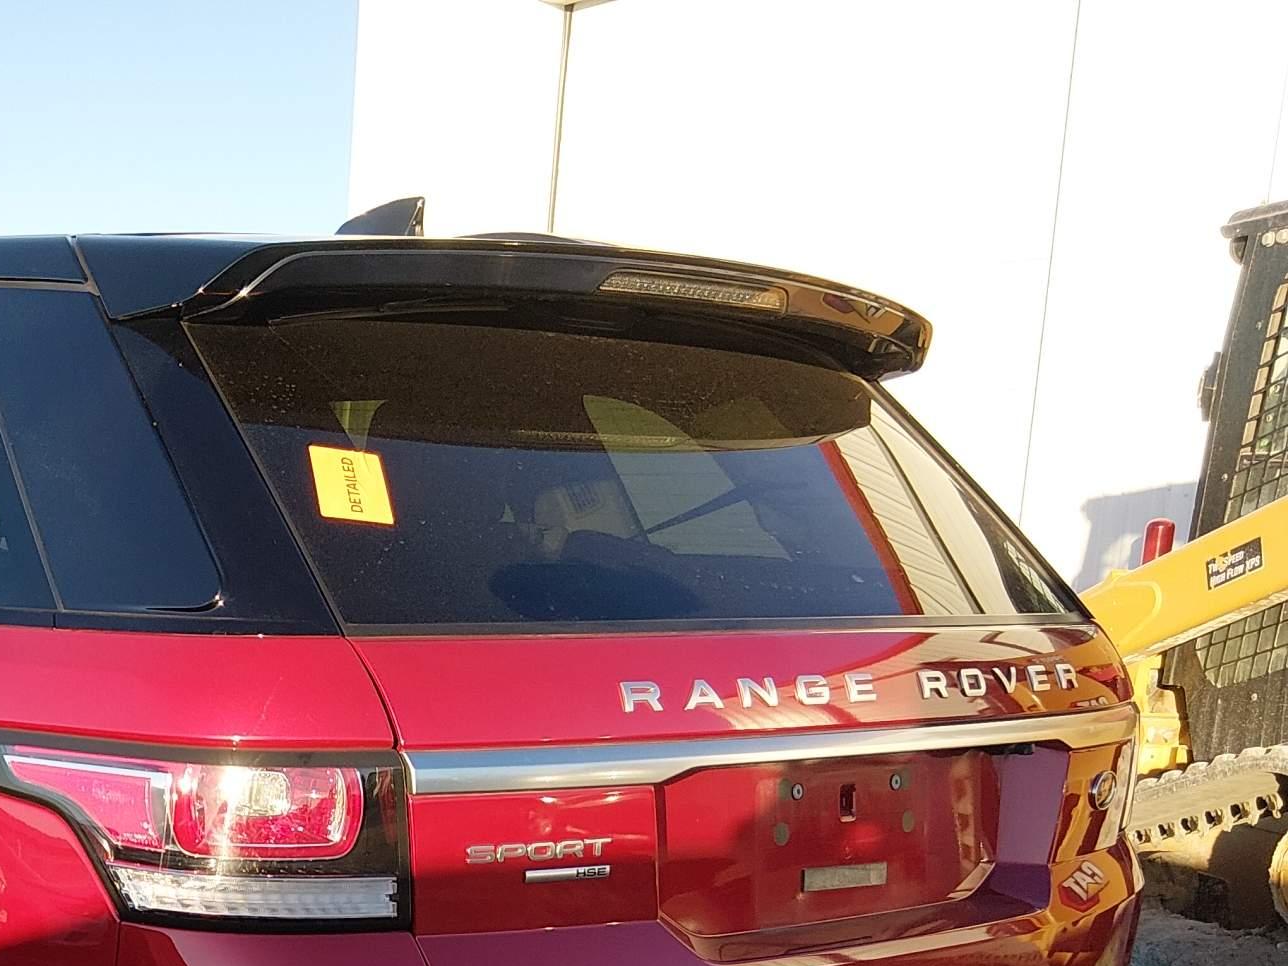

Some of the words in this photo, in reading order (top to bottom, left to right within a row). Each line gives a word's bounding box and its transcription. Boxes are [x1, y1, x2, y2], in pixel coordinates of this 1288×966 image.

[341, 456, 364, 513] DETAILED
[619, 672, 878, 713] RANGE
[917, 662, 1080, 700] ROVER
[466, 837, 613, 864] SPORT
[575, 866, 608, 878] HSE
